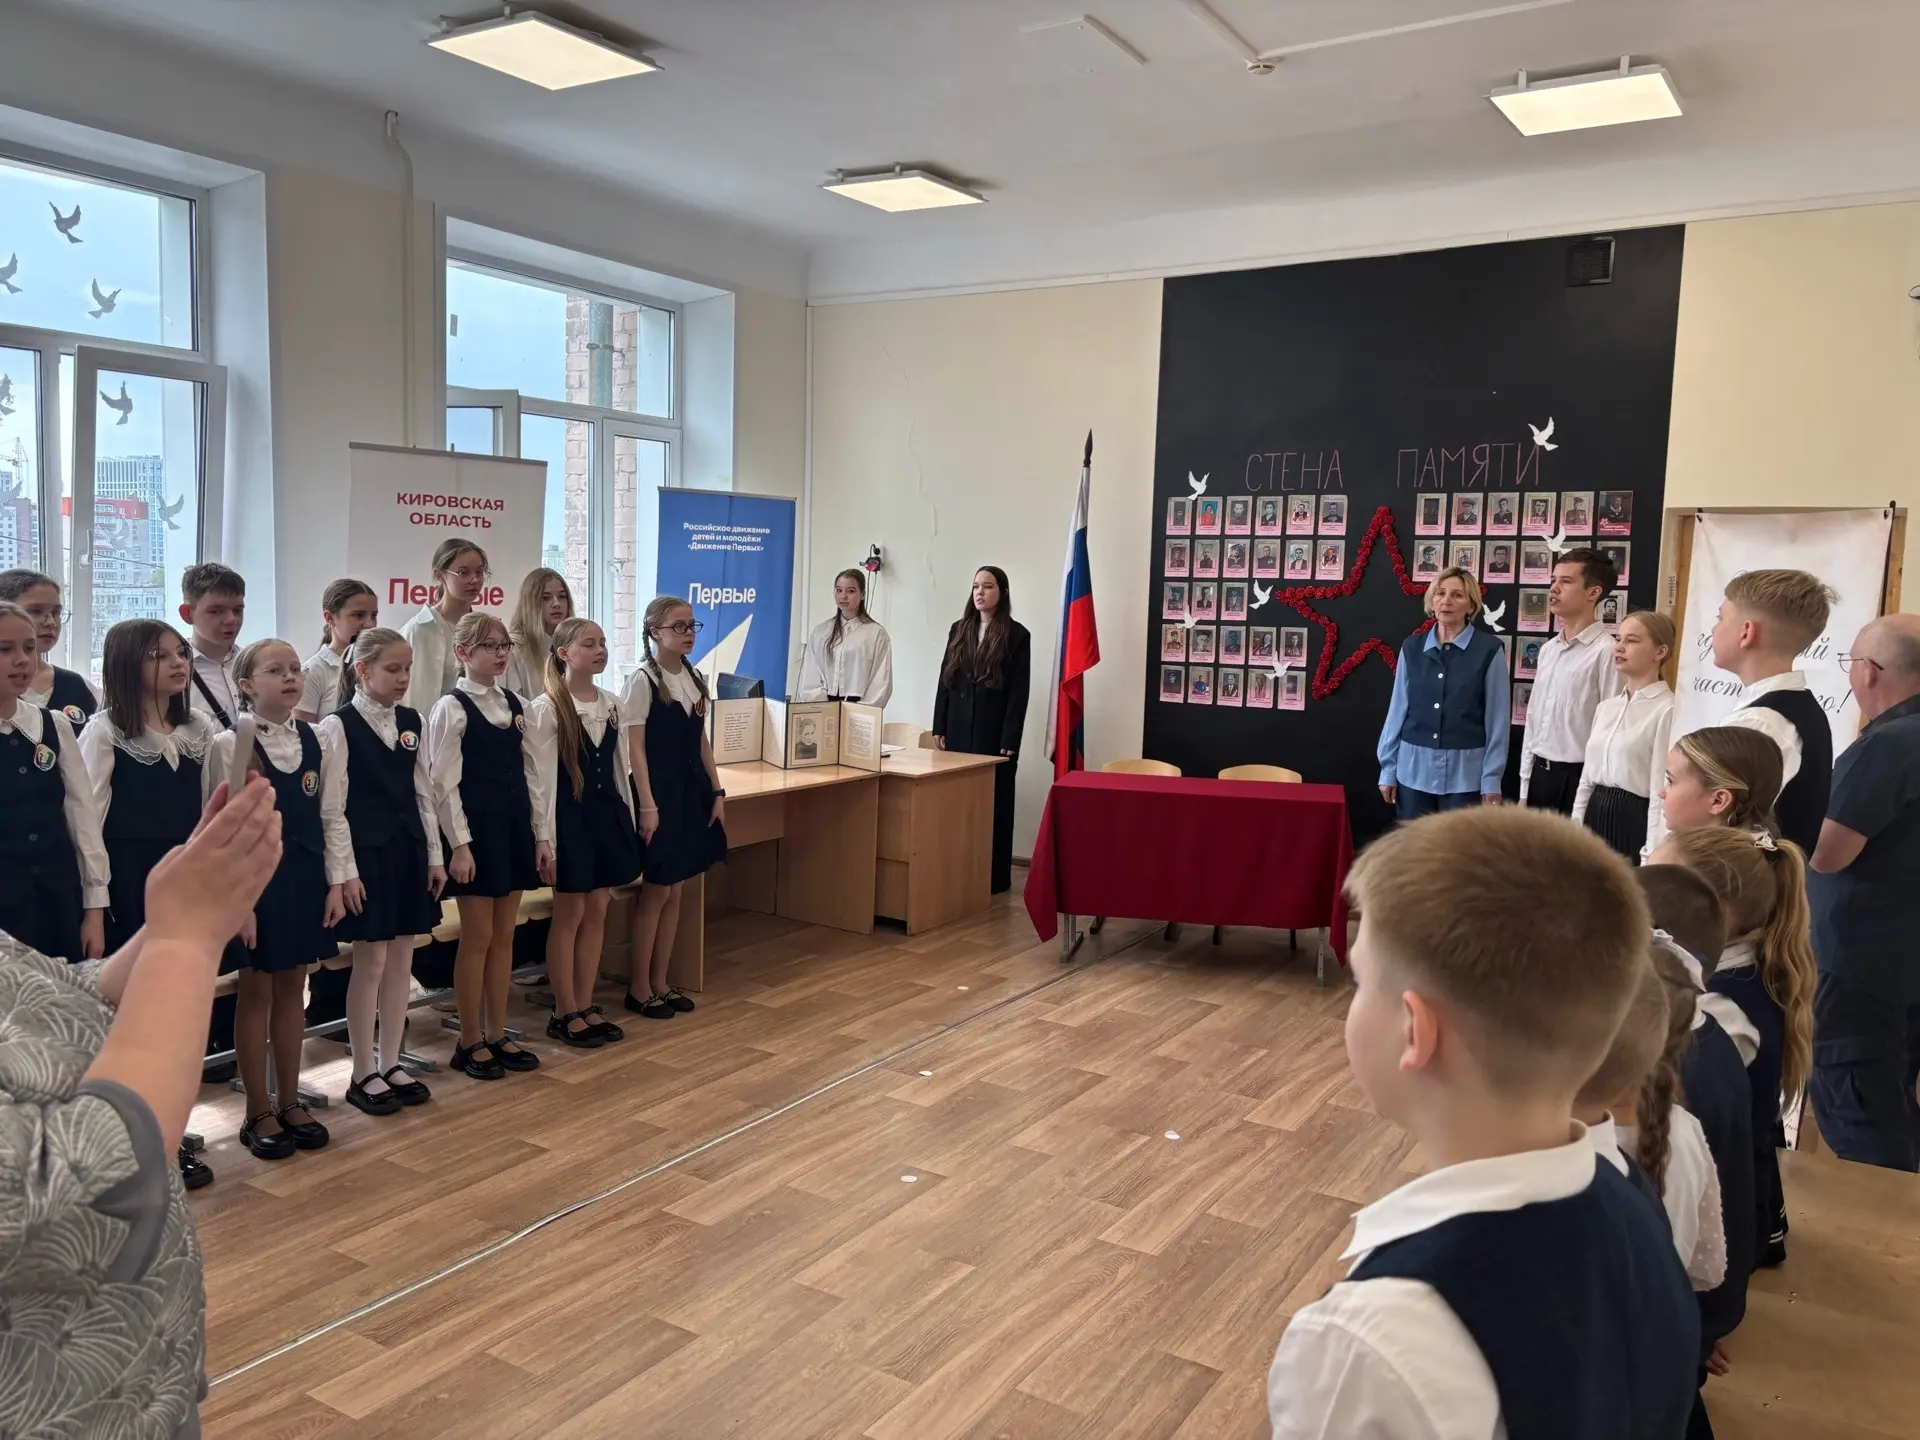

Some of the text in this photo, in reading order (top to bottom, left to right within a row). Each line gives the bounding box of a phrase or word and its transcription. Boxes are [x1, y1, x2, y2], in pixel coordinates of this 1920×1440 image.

[1245, 442, 1540, 492] СТЕНА ПАМЯТИ
[396, 492, 505, 511] КИРОВСКАЯ
[409, 512, 492, 529] ОБЛАСТЬ
[683, 522, 771, 534] Российское движение
[692, 532, 715, 541] детей
[388, 577, 505, 606] Пеые
[688, 582, 757, 611] Первые
